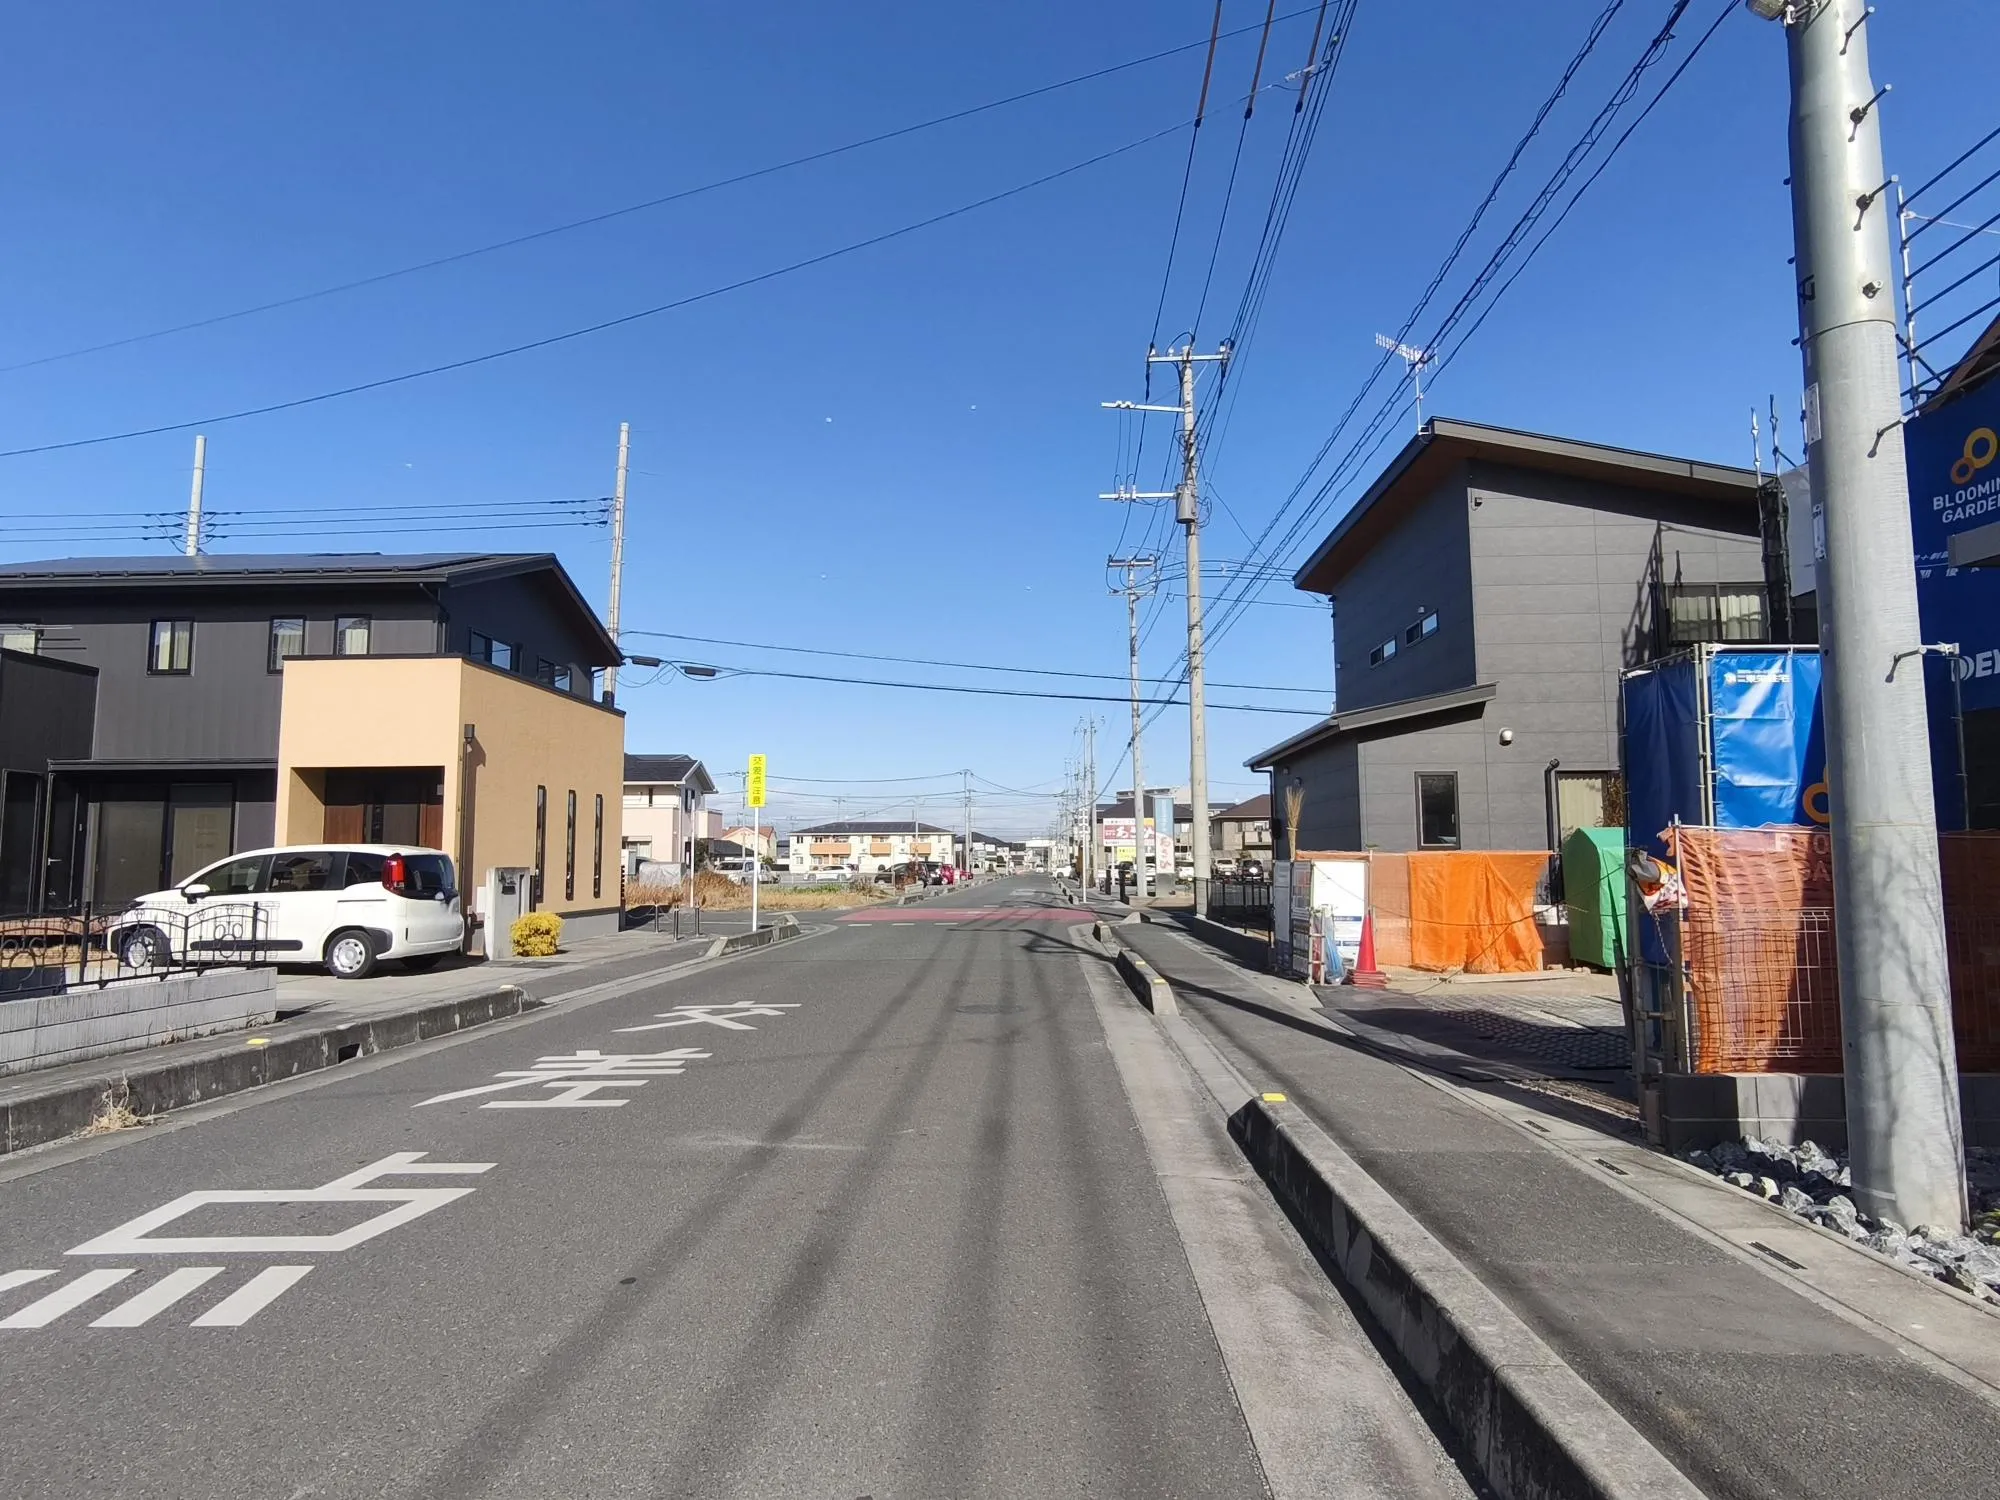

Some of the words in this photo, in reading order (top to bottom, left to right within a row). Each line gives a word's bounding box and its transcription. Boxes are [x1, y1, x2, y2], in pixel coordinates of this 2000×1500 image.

[1941, 494, 2000, 524] GARDE
[752, 756, 763, 805] 交差点注意
